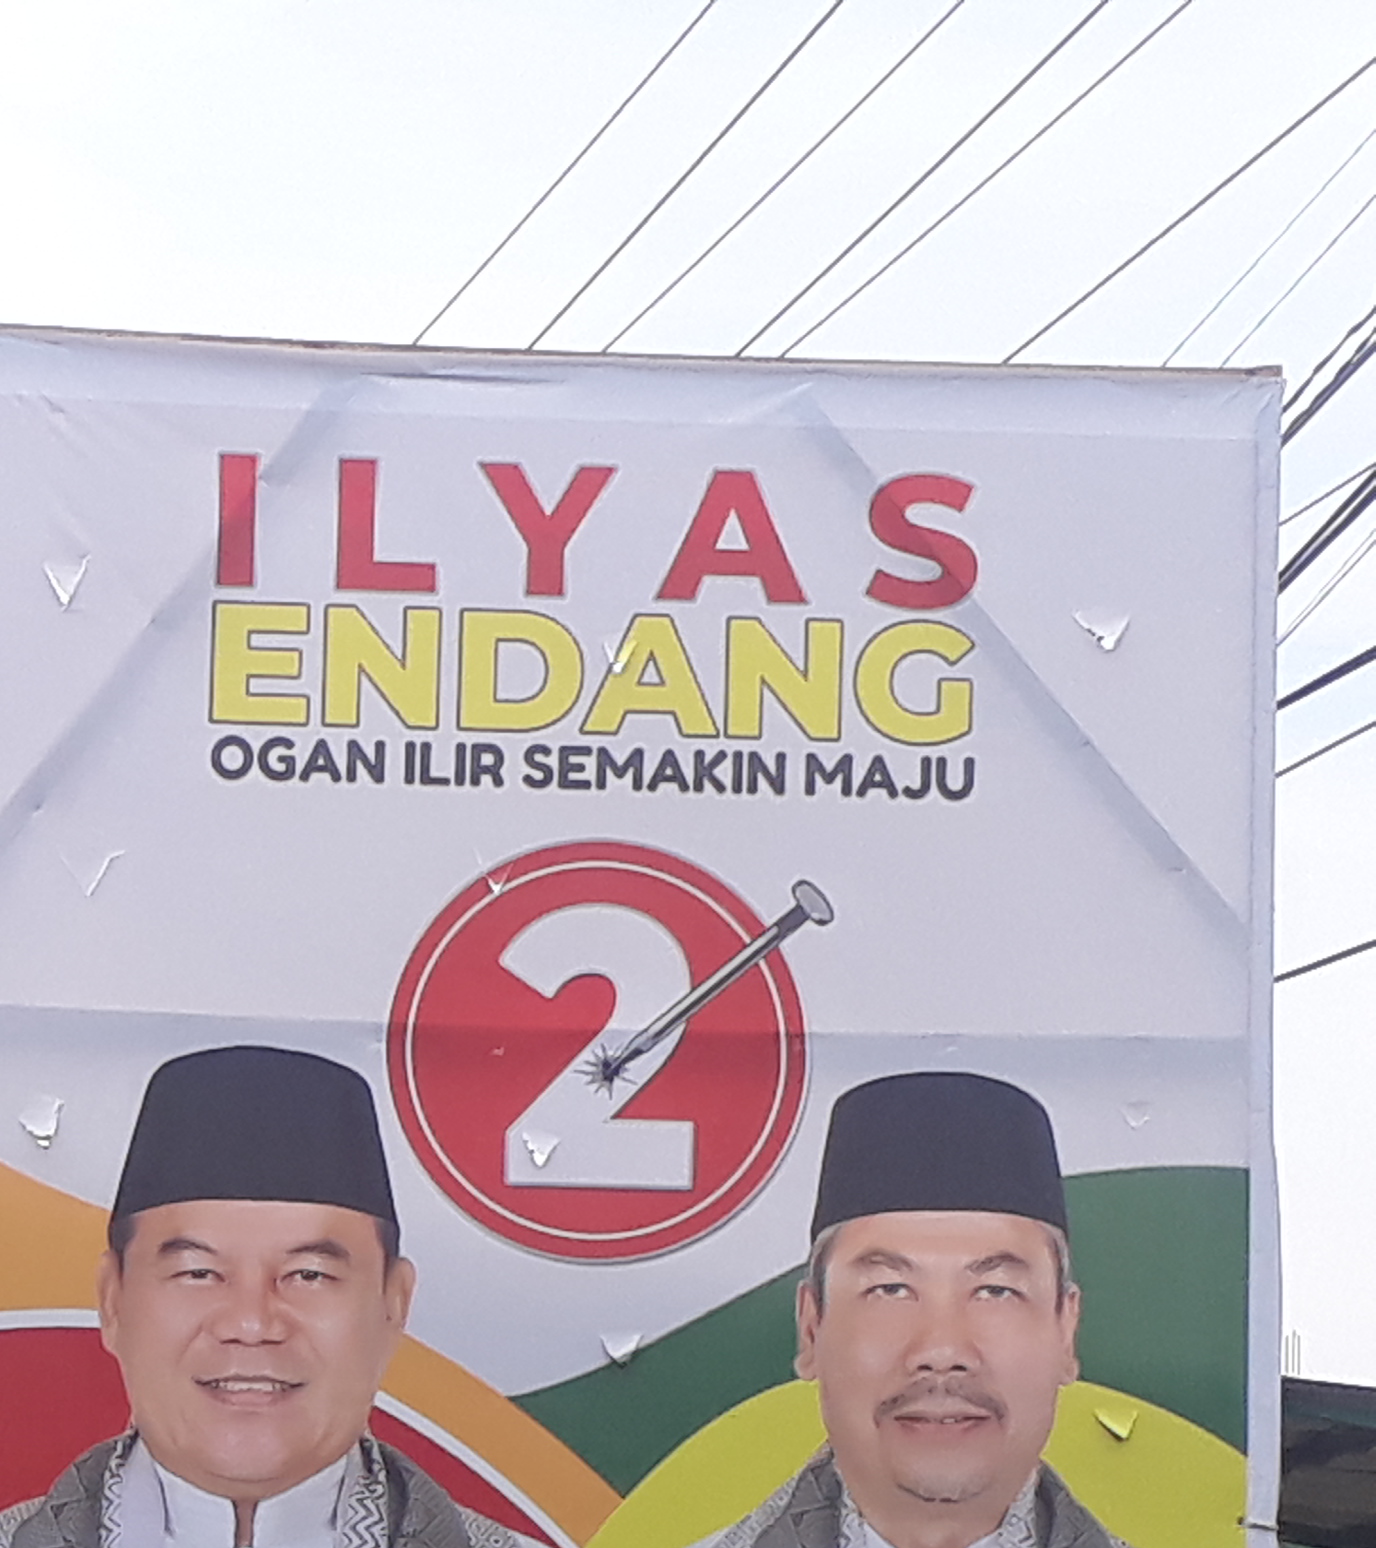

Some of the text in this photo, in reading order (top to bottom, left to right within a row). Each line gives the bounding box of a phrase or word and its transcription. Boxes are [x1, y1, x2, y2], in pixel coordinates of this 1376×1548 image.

[216, 453, 978, 609] ILYAS
[207, 601, 976, 745] ENDANG
[210, 735, 977, 801] OGAN ILIR SEMAKIN MAJU
[498, 904, 696, 1188] 2
